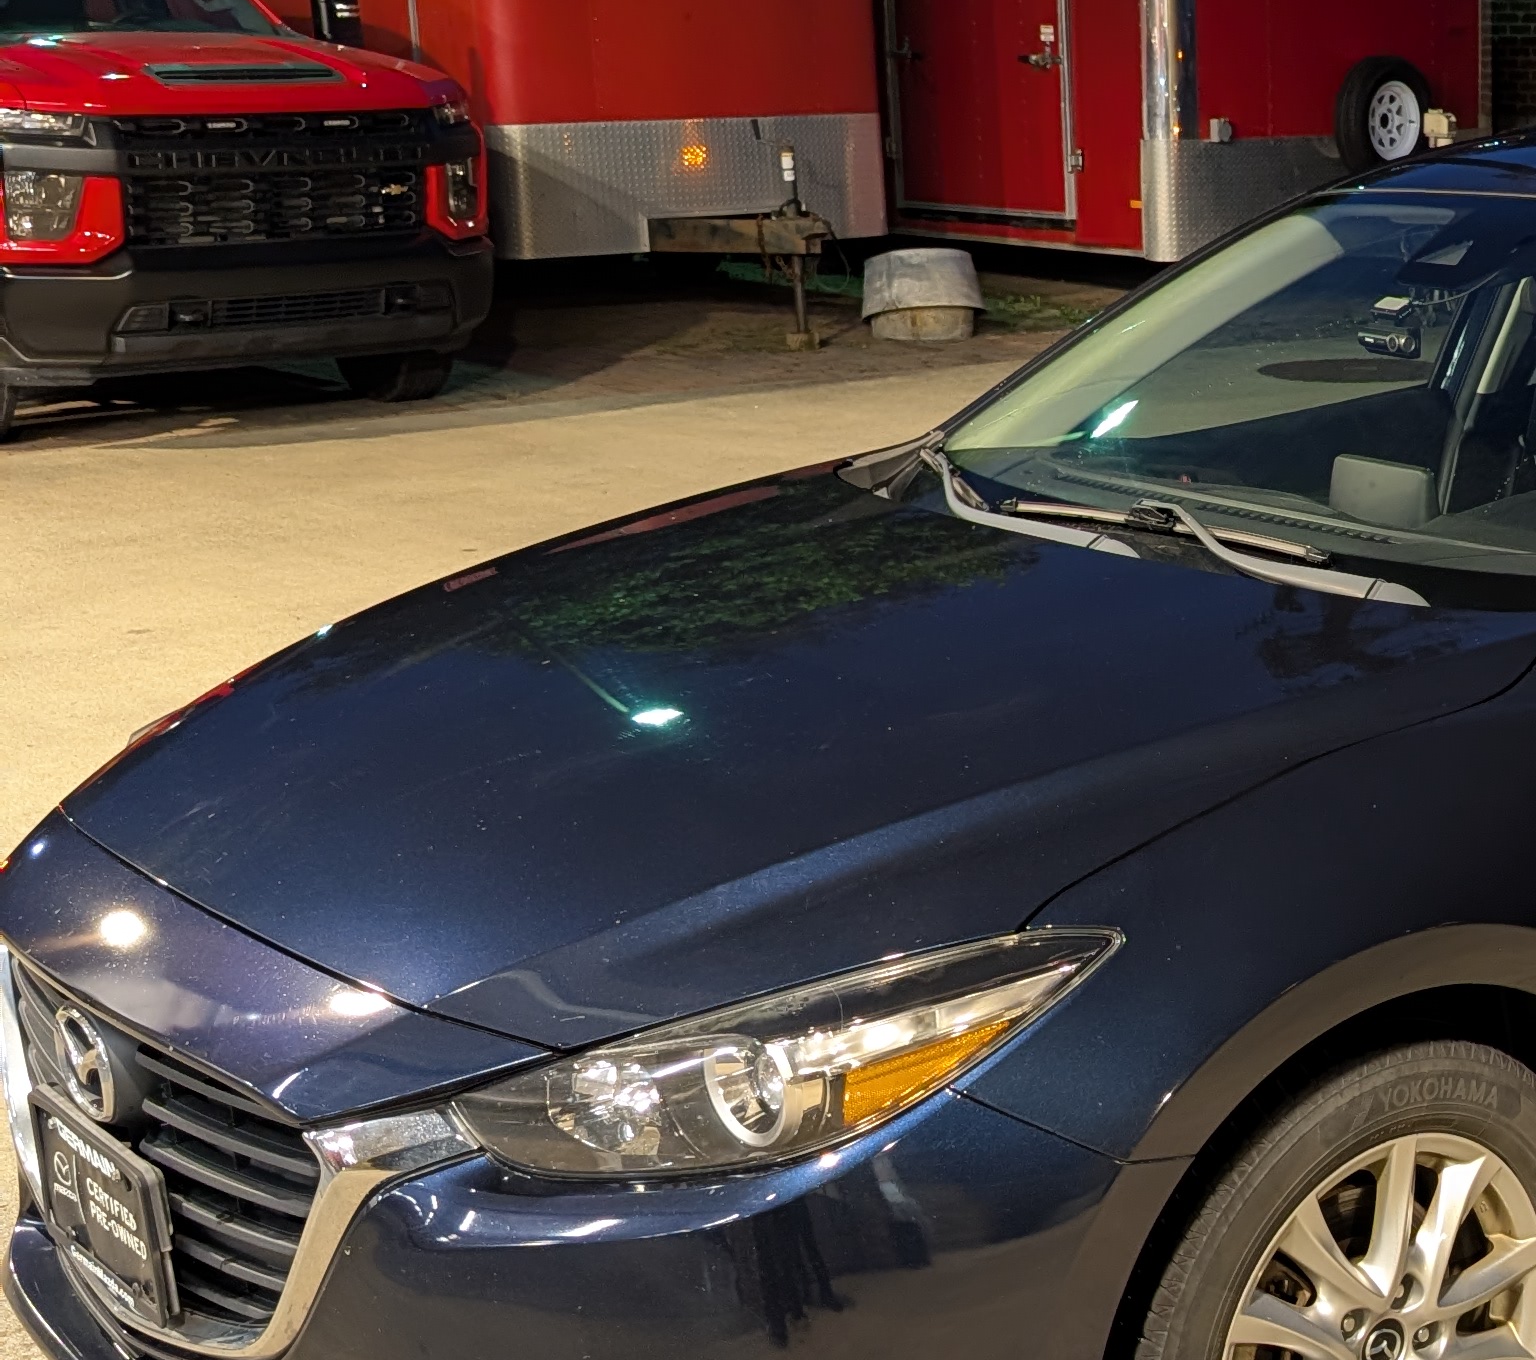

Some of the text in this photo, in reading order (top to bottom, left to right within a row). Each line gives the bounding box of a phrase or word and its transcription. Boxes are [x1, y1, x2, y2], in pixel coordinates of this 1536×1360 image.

[1378, 1076, 1498, 1112] YOKOHAMA
[56, 1119, 116, 1179] GERMAIN
[86, 1177, 137, 1232] CERTIFIED
[90, 1199, 147, 1261] PRE-OWNED
